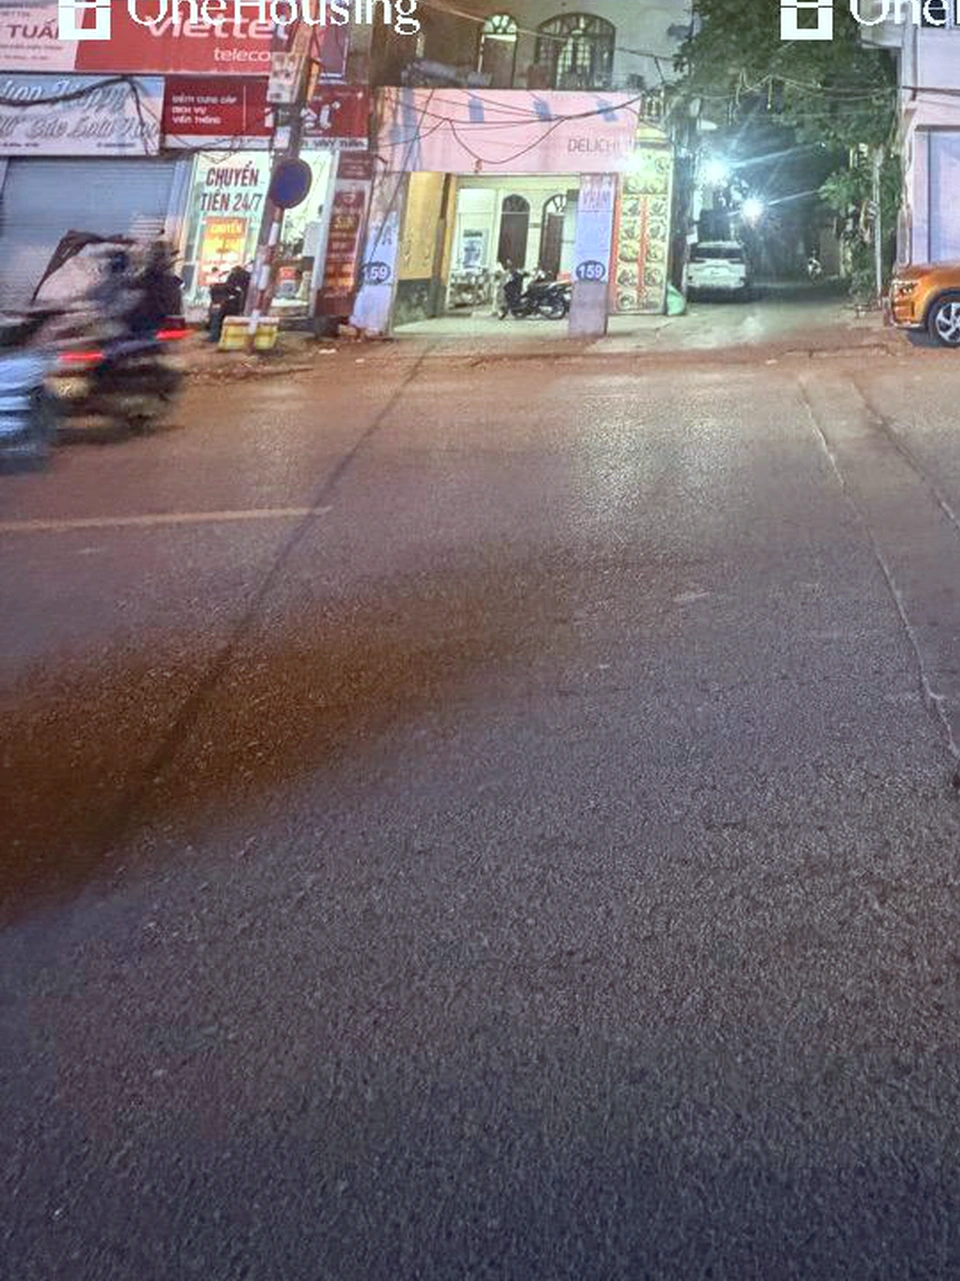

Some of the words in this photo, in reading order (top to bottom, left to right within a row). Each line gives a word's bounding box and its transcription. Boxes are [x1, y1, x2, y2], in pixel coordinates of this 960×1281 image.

[7, 18, 59, 39] TUẤ
[213, 46, 272, 62] teleco
[206, 160, 259, 187] CHUYỂN
[233, 193, 264, 212] 24/7
[578, 264, 603, 277] 159
